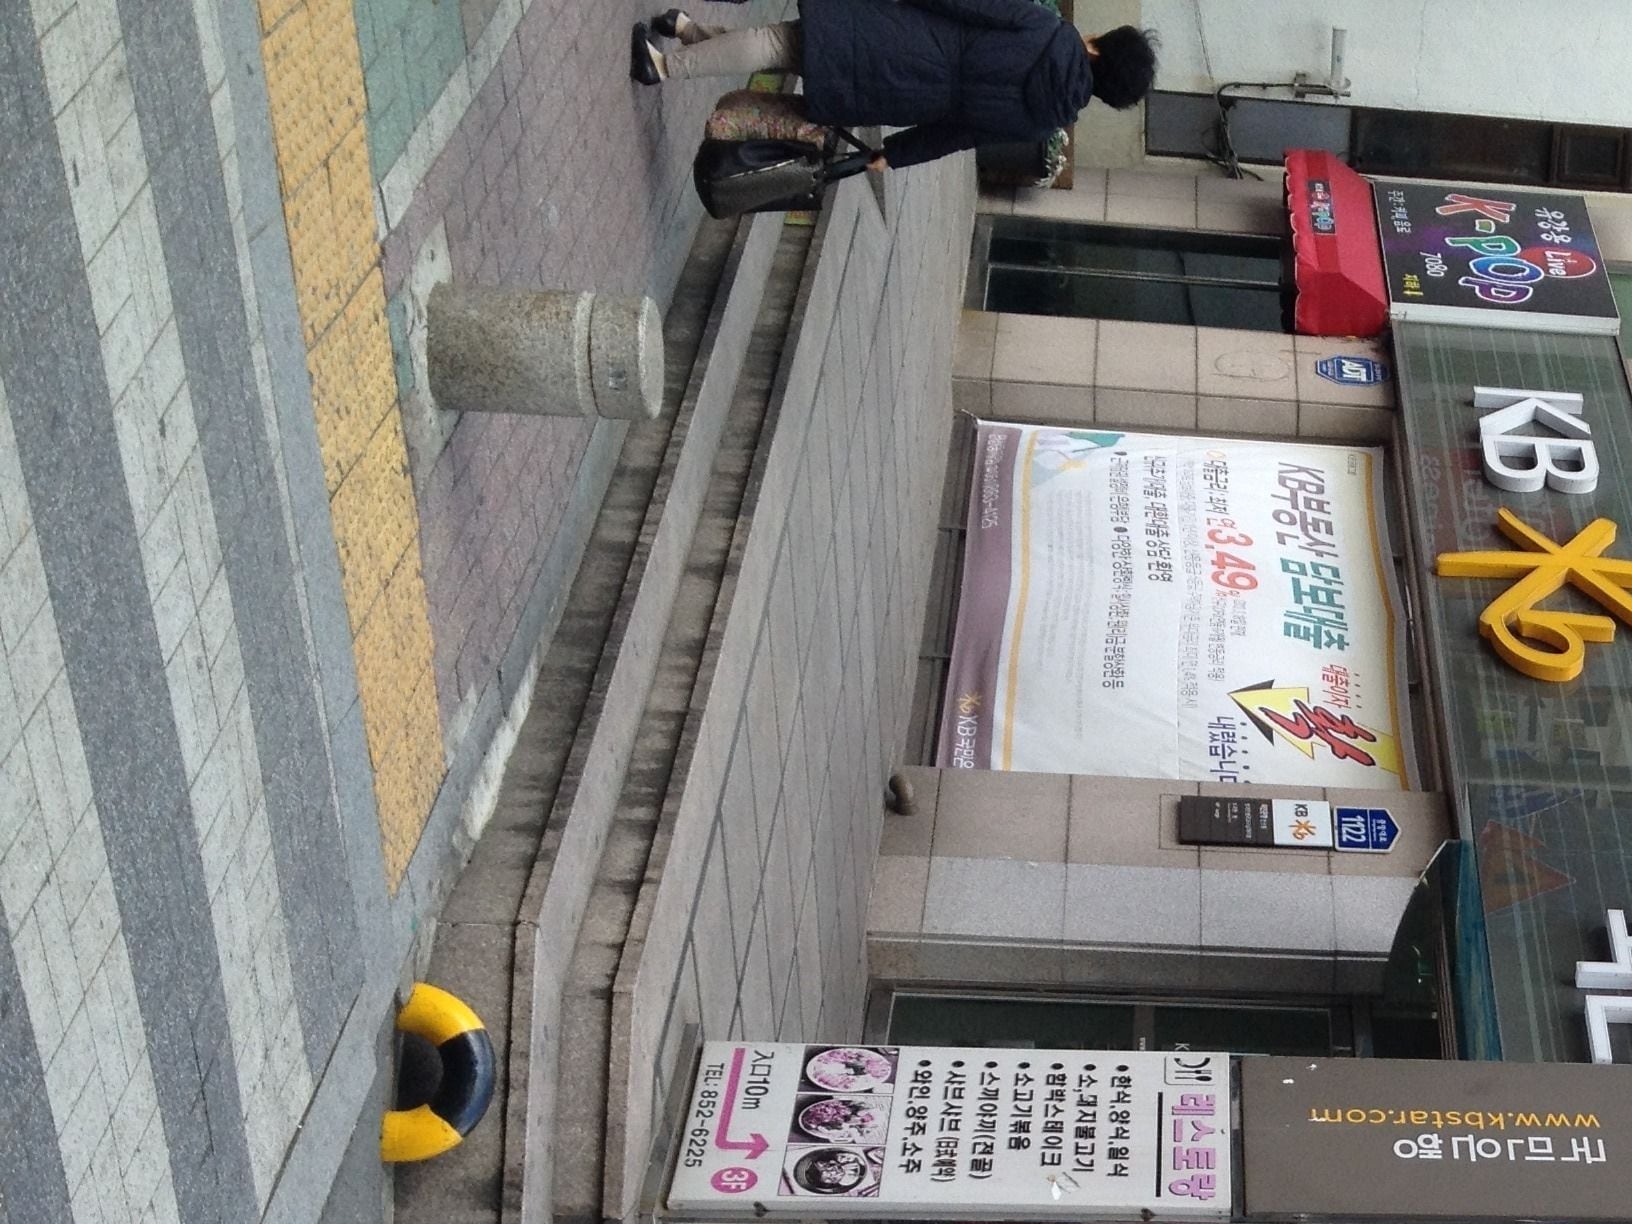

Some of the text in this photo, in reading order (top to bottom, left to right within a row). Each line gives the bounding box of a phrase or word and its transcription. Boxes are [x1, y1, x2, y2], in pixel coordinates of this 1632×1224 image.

[1419, 251, 1449, 277] 7080
[1436, 194, 1545, 304] K-POP
[1544, 250, 1578, 277] Live
[1341, 360, 1367, 382] ADT
[1473, 385, 1600, 494] KB
[1271, 462, 1350, 651] KB부동산 담보대출
[1322, 664, 1352, 709] 대출이자
[1294, 803, 1309, 817] KB
[1341, 815, 1366, 843] 1122
[683, 1062, 726, 1168] TEL: 852-6225
[939, 1070, 967, 1132] 샤브샤브
[1008, 1072, 1035, 1151] 소고기볶음
[1040, 1072, 1068, 1167] 함박스테이크
[1309, 1108, 1601, 1131] www.kbstar.com
[1168, 1093, 1217, 1201] 레스토랑
[1393, 1133, 1608, 1165] 국민은행
[719, 1169, 750, 1191] 3F
